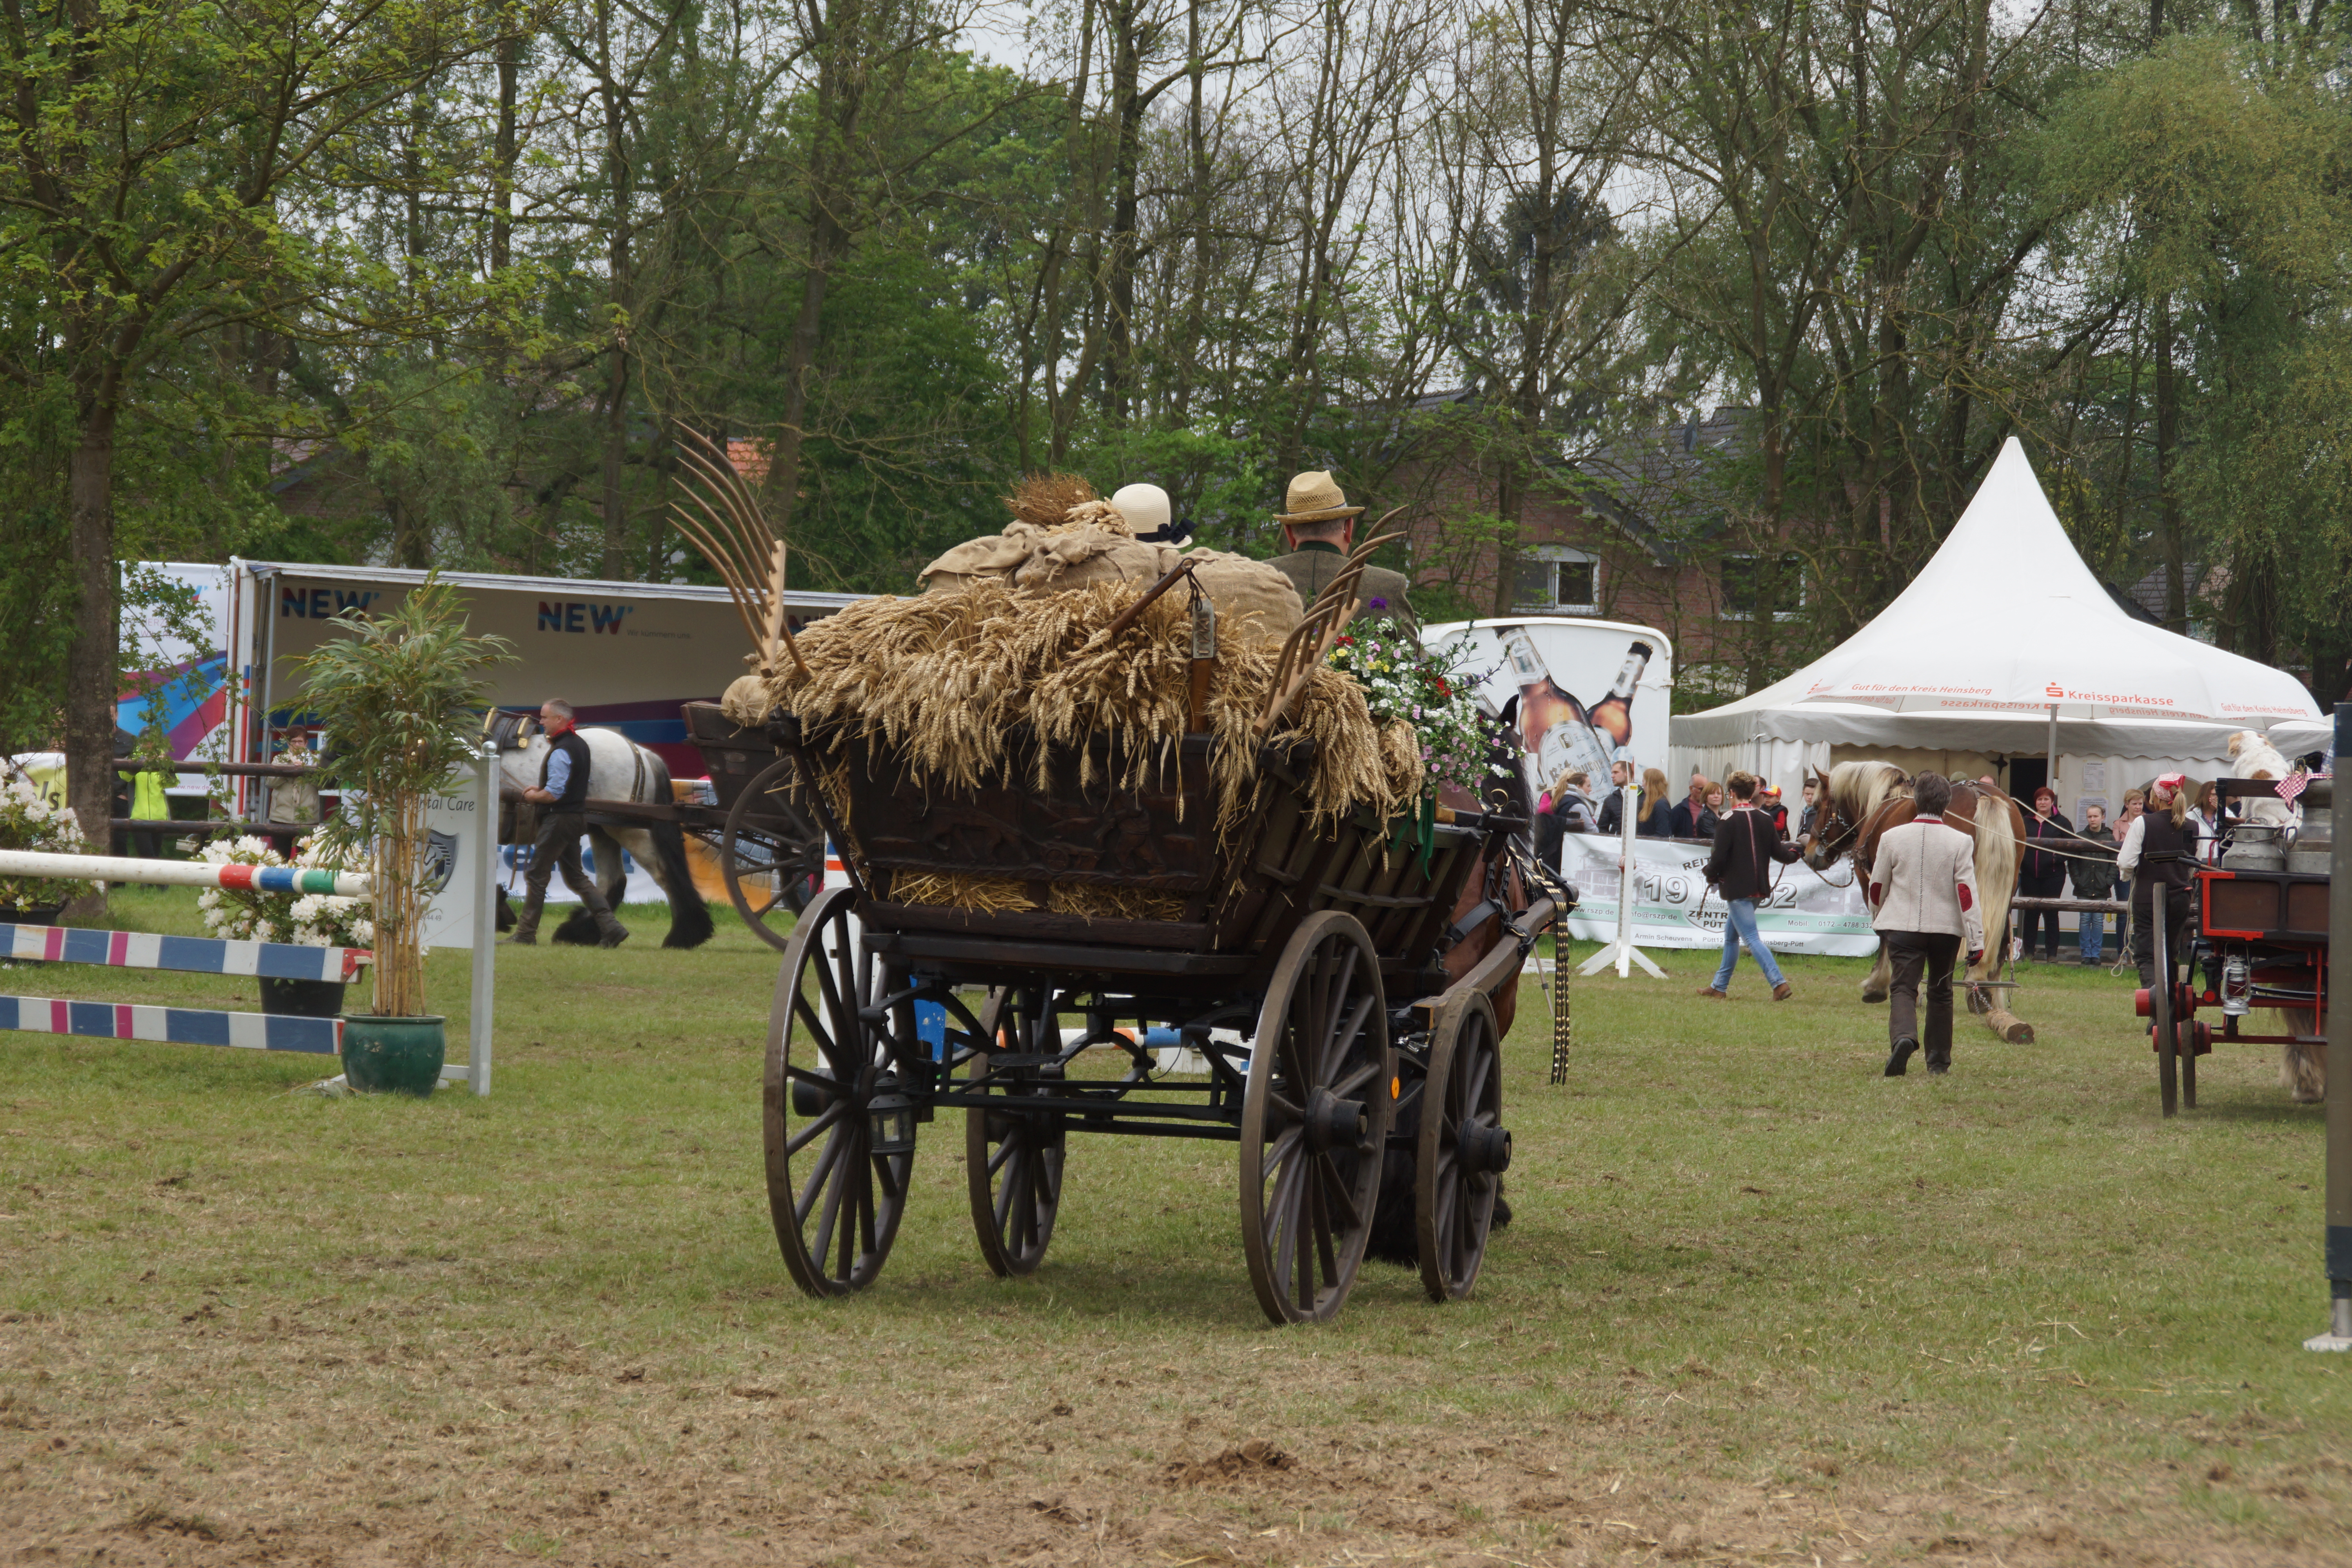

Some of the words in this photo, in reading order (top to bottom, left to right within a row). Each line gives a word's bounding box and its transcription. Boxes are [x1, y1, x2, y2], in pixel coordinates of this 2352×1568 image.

[1939, 686, 1993, 696] Heinsberg
[2068, 691, 2174, 706] Kreissparkasse
[2221, 703, 2232, 711] Gut
[2231, 703, 2241, 712] für
[2254, 705, 2272, 713] Kreis
[2271, 706, 2308, 717] Heinsberg
[447, 797, 475, 811] Care
[1644, 875, 1688, 904] 19
[1573, 907, 1614, 916] ww.rszp.de
[1688, 910, 1728, 919] ZENTR
[1656, 934, 1693, 942] Scheuvens
